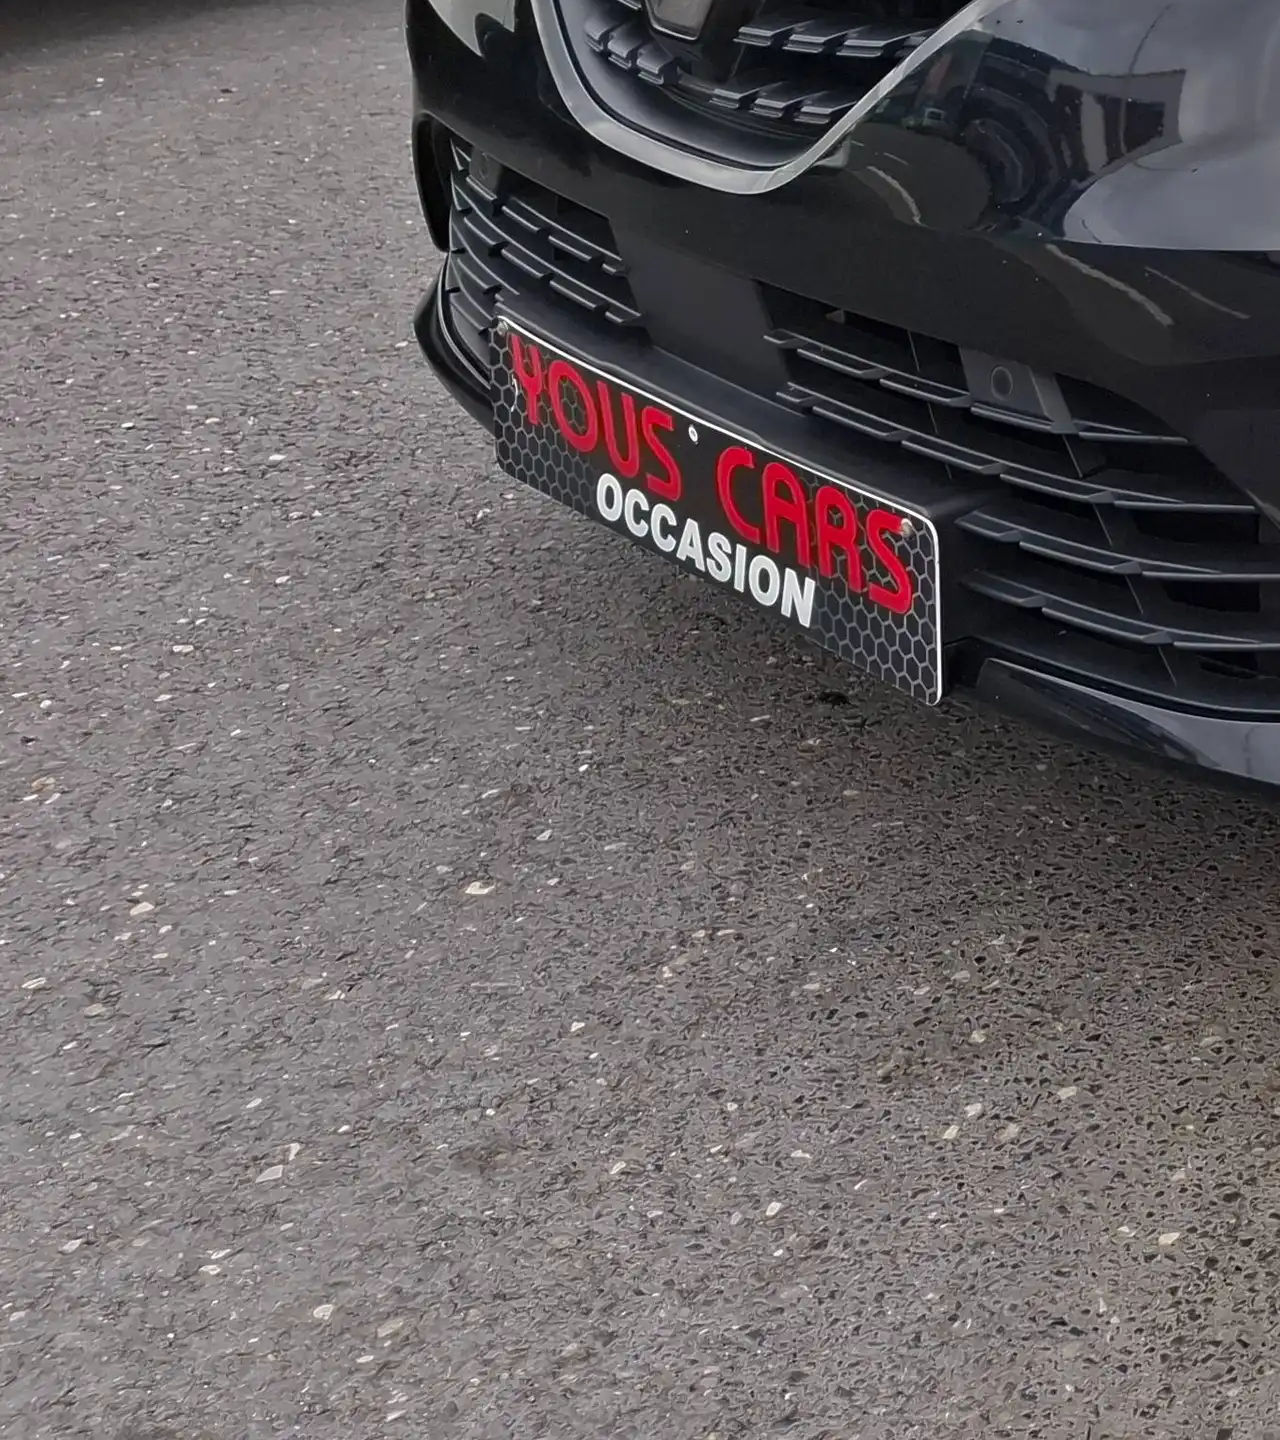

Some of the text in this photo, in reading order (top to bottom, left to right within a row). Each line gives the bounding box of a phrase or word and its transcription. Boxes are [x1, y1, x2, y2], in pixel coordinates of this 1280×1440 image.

[509, 332, 913, 615] YOUS CARS
[596, 472, 816, 628] OCCASION
